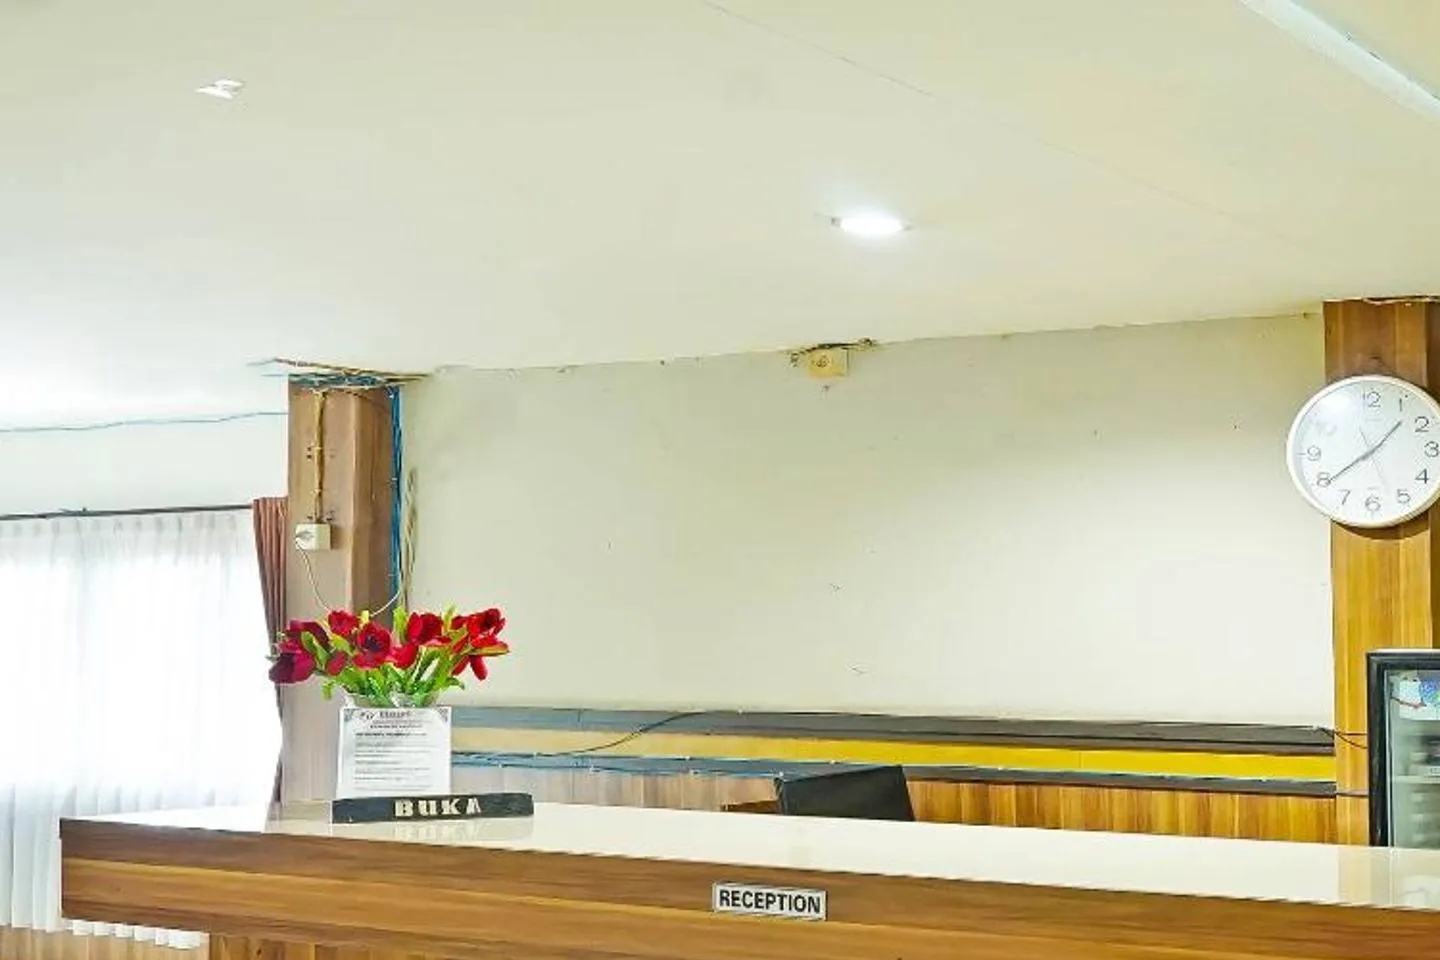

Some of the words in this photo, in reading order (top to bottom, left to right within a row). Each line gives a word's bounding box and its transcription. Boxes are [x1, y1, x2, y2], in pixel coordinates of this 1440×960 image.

[1414, 416, 1430, 433] 2
[1307, 445, 1322, 461] 9
[1424, 441, 1440, 458] 3
[1316, 472, 1331, 488] 8
[1415, 468, 1430, 484] 4
[1339, 489, 1351, 505] 7
[1365, 496, 1381, 512] 6
[1396, 488, 1411, 504] 5
[395, 797, 482, 817] BUKA
[719, 889, 821, 914] RECEPTION
